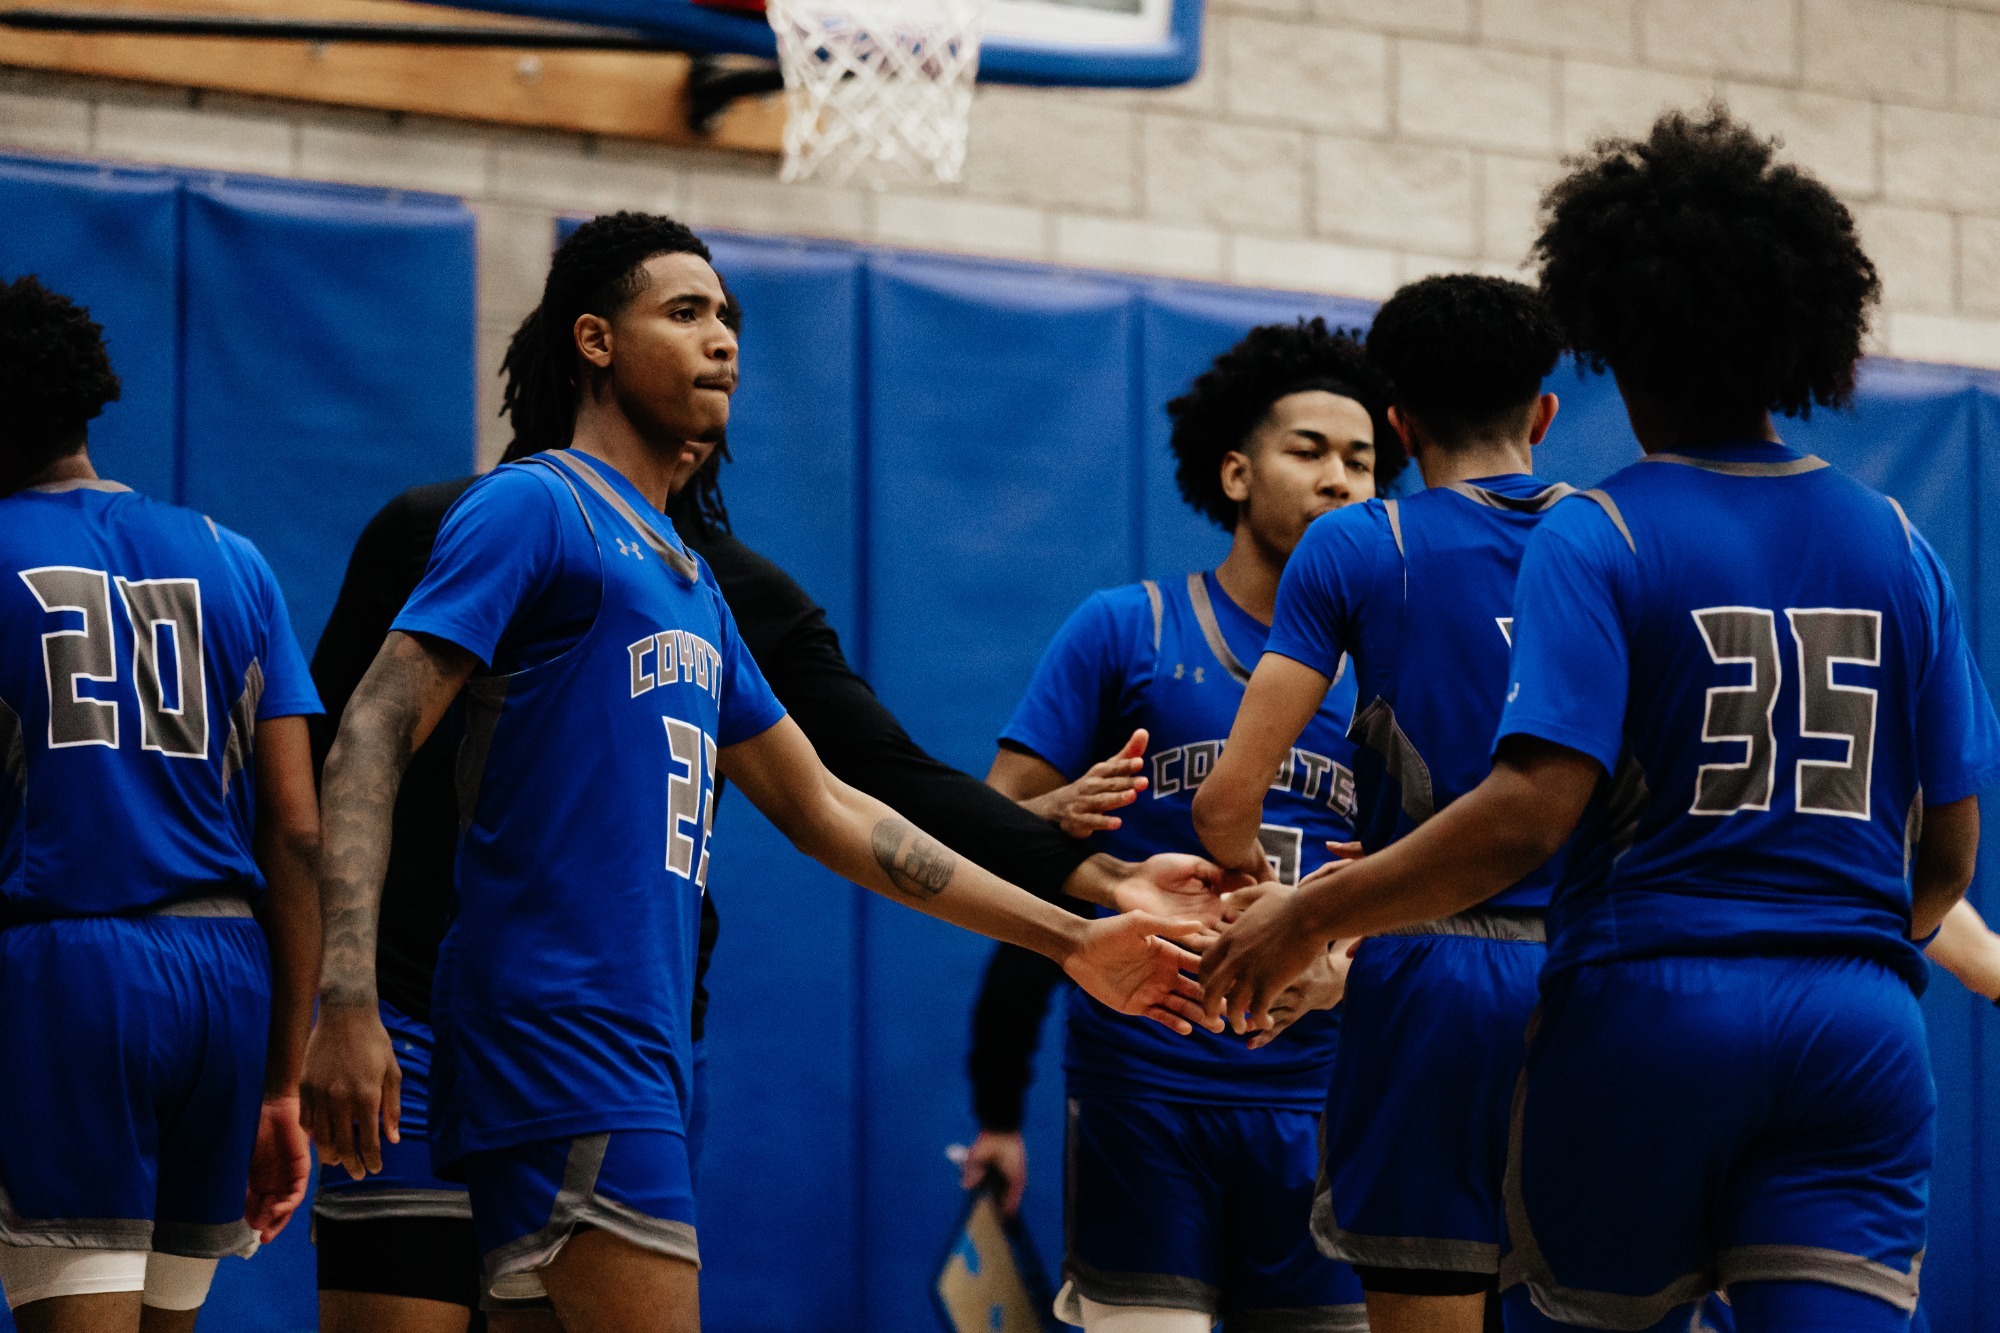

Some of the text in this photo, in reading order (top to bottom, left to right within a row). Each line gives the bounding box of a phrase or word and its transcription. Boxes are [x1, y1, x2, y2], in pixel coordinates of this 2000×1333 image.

[18, 565, 209, 760] 20
[627, 629, 722, 712] COYOT
[1688, 606, 1882, 821] 35
[1151, 739, 1358, 830] COTE
